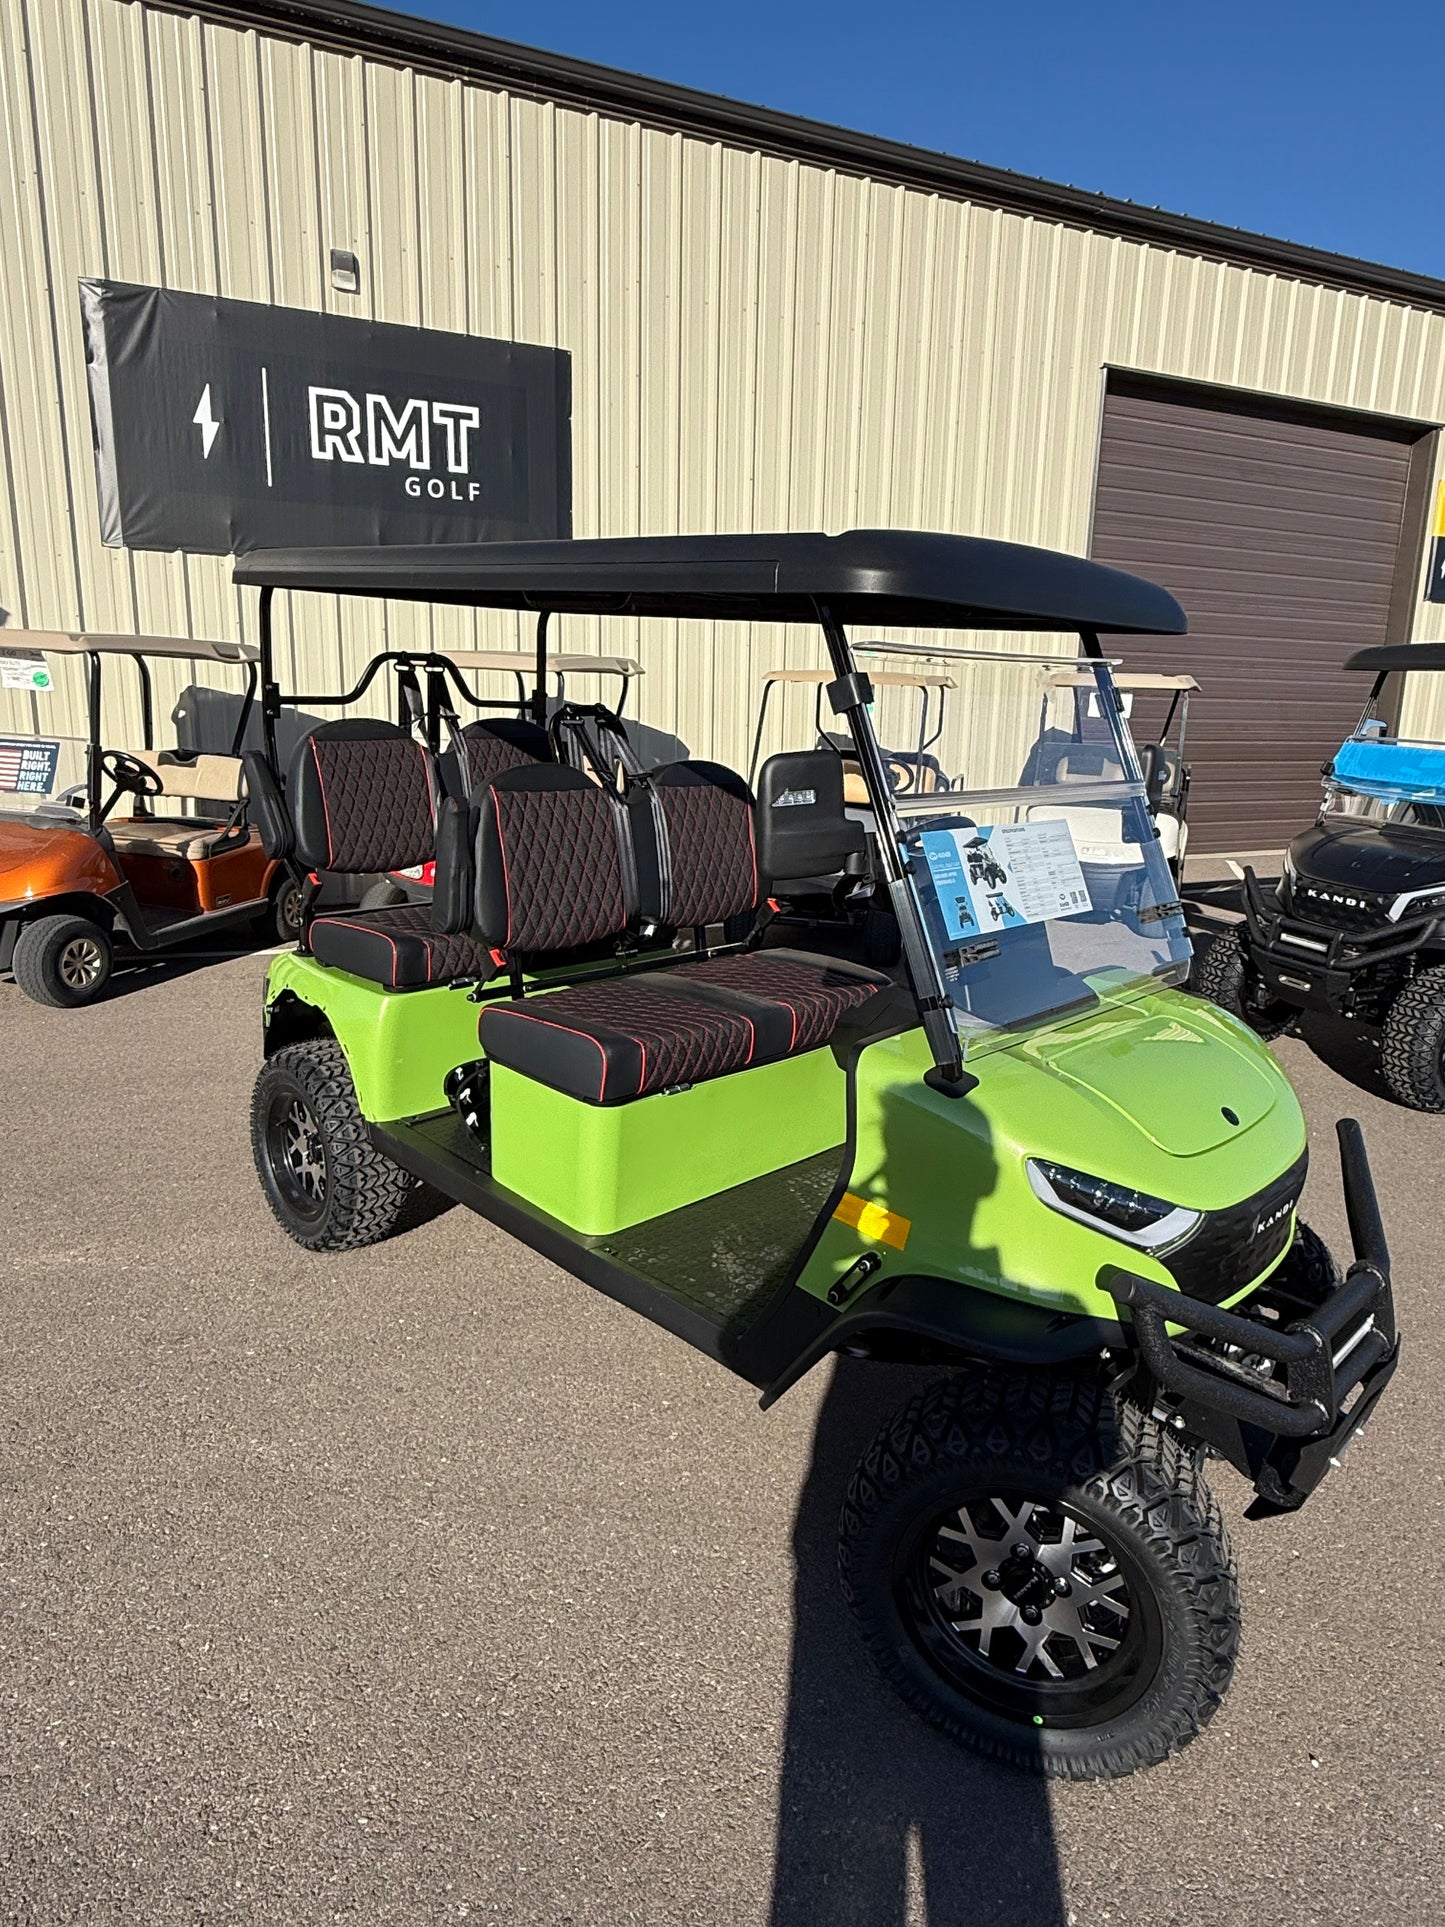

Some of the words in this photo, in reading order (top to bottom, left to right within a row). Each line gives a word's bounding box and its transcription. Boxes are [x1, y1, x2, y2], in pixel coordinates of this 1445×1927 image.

[308, 386, 480, 474] RMT
[405, 476, 480, 501] GOLF
[22, 750, 51, 761] BUILT
[21, 760, 52, 772] RIGHT.
[19, 771, 49, 782] RIGHT
[16, 781, 46, 792] HERE.
[1307, 889, 1366, 909] KANDI
[1257, 1199, 1293, 1234] KANDI
